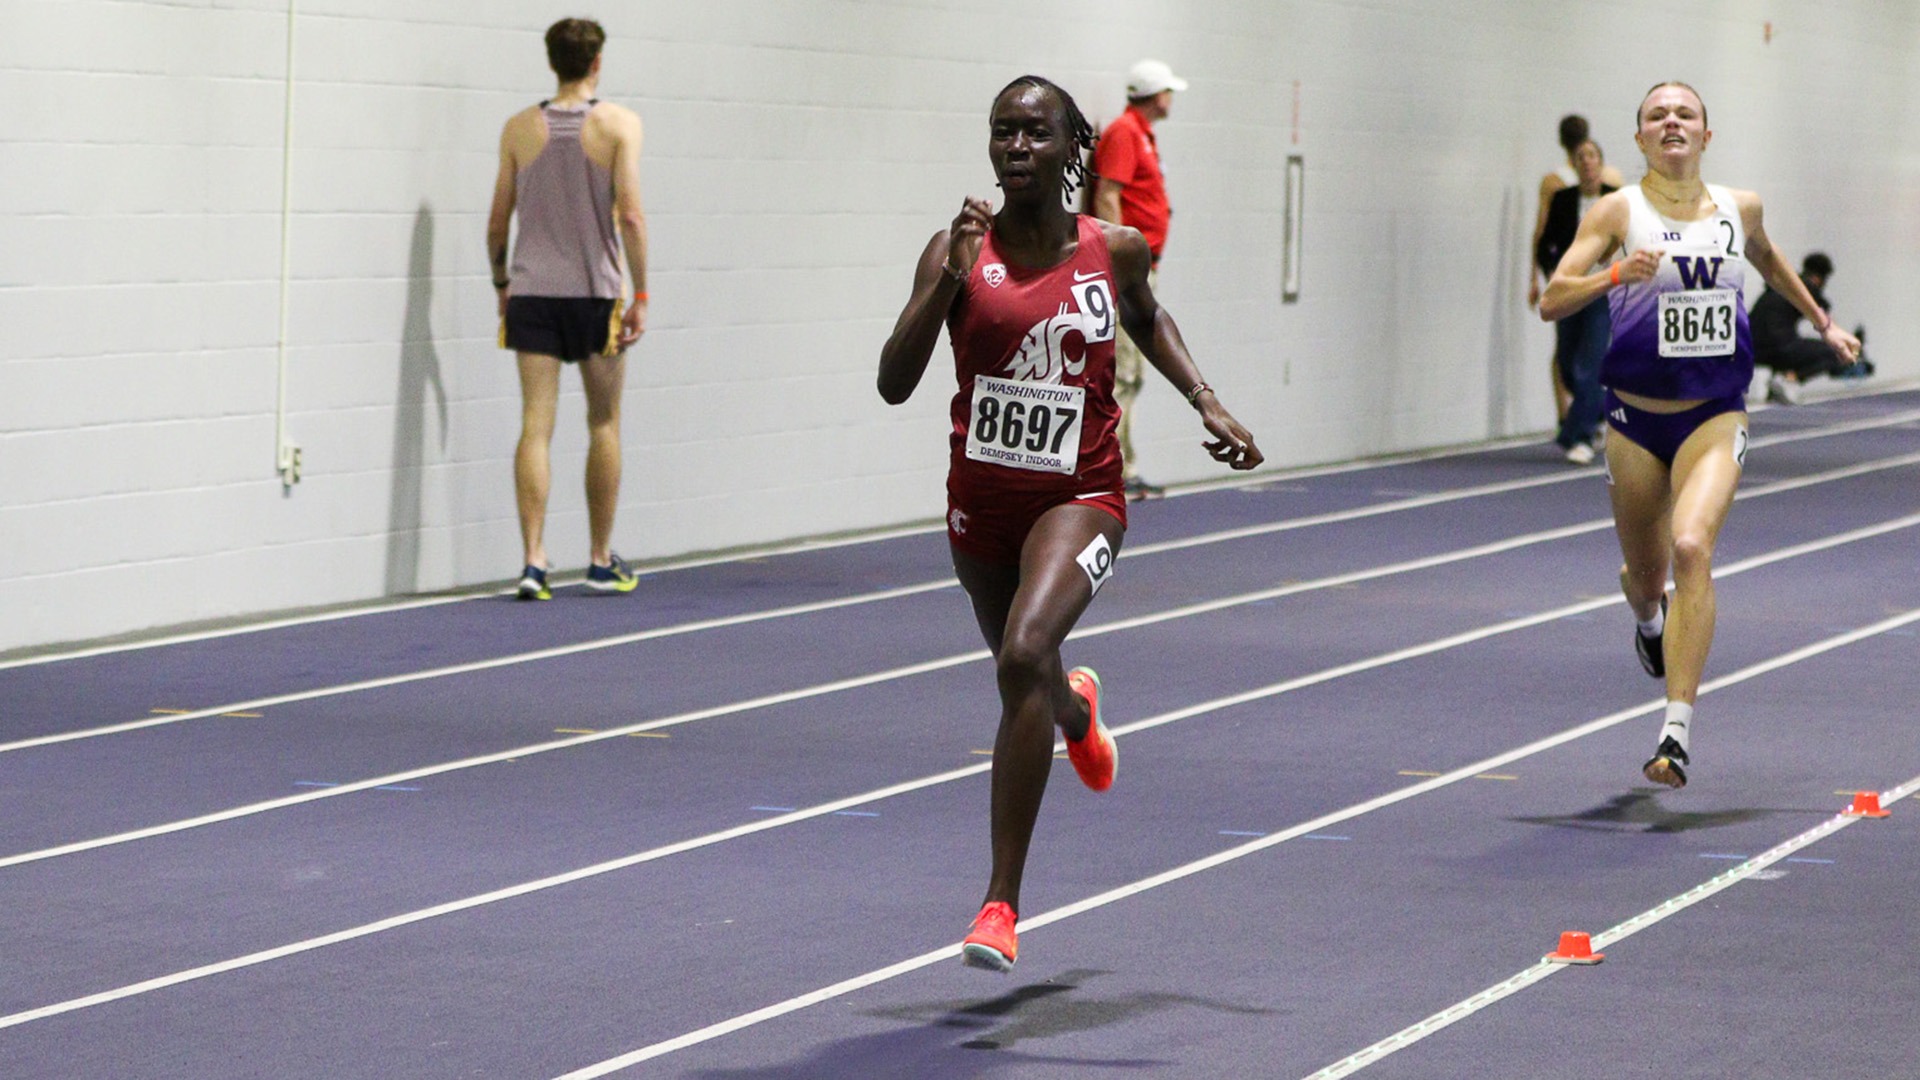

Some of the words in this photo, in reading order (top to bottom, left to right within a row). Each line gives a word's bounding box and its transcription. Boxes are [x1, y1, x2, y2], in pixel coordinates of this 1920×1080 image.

[1720, 220, 1739, 257] 2
[1672, 256, 1724, 290] W
[1084, 284, 1111, 337] 9
[1667, 293, 1728, 305] WASHINGTON
[1664, 305, 1732, 343] 8643
[986, 381, 1074, 403] WASHINGTON
[975, 396, 1078, 455] 8697
[980, 446, 1024, 464] DEMPSEY
[1025, 455, 1062, 468] INDOOR
[1086, 546, 1111, 581] 9
